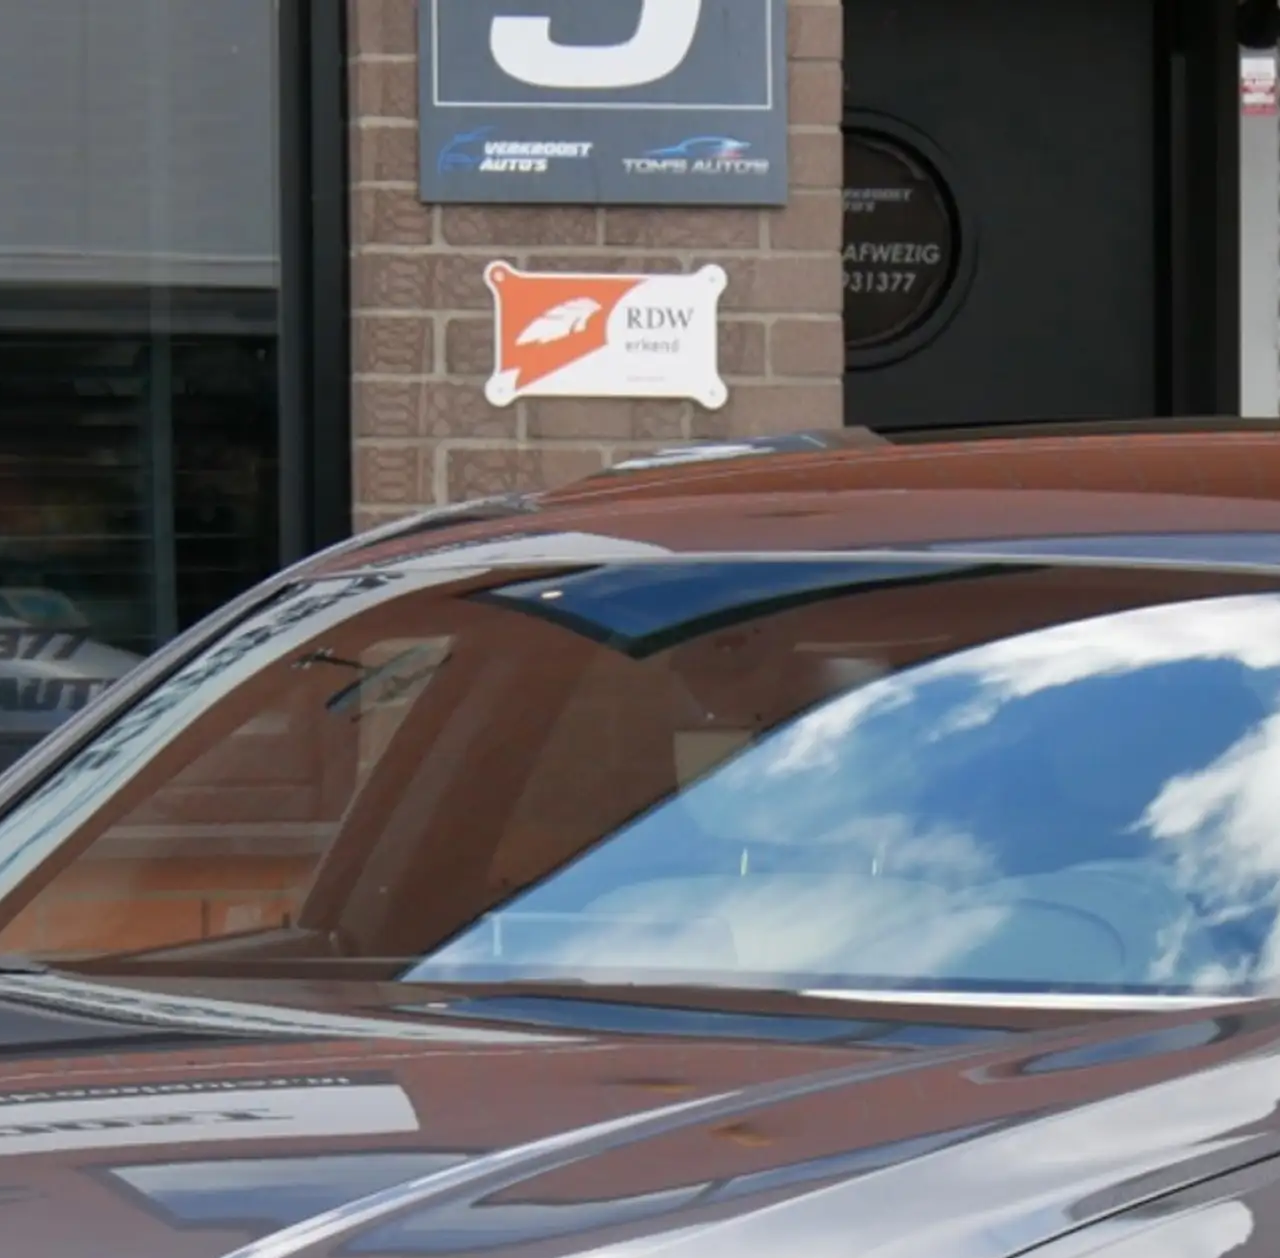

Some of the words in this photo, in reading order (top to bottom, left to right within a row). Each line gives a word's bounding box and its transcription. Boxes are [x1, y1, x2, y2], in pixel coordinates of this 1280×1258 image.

[484, 141, 593, 158] VERKROOST
[843, 242, 941, 264] AFWEZIG
[626, 306, 695, 331] RDW
